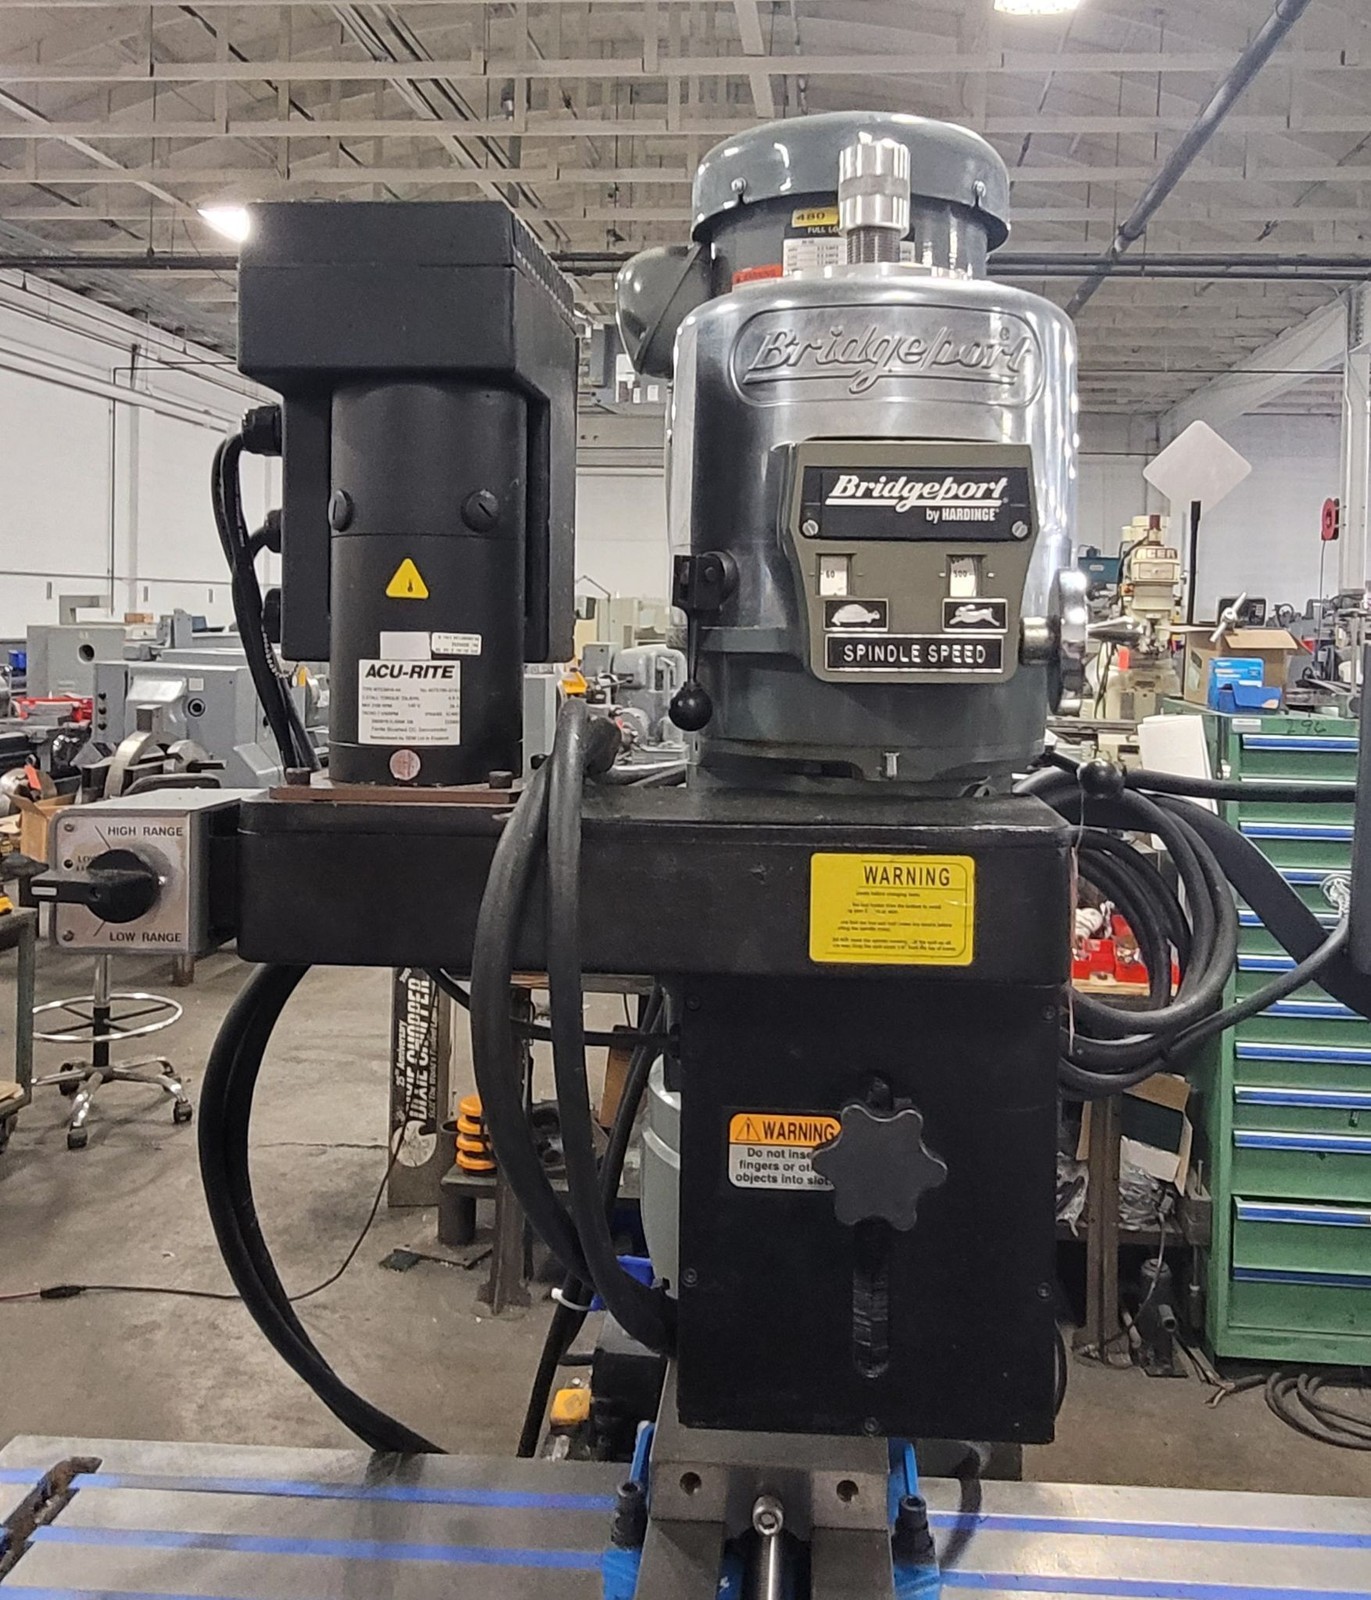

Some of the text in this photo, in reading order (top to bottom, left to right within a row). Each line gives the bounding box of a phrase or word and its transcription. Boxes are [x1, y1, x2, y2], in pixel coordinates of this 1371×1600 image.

[828, 225, 840, 234] LO
[748, 327, 1031, 394] Bridgeport
[827, 475, 1008, 512] Bridgeport
[926, 508, 996, 524] by HARDINGE
[843, 644, 987, 663] SPINDLE SPEED
[365, 664, 455, 678] ACU-RITE
[107, 826, 183, 837] HIGH RANGE
[864, 865, 950, 886] WARNING
[109, 932, 182, 942] LOW RANGE
[762, 1120, 835, 1142] WARNING
[747, 1147, 763, 1158] Do
[766, 1149, 785, 1159] not
[739, 1160, 780, 1172] fingers
[783, 1163, 796, 1171] or
[735, 1172, 778, 1184] objects
[781, 1174, 804, 1185] into
